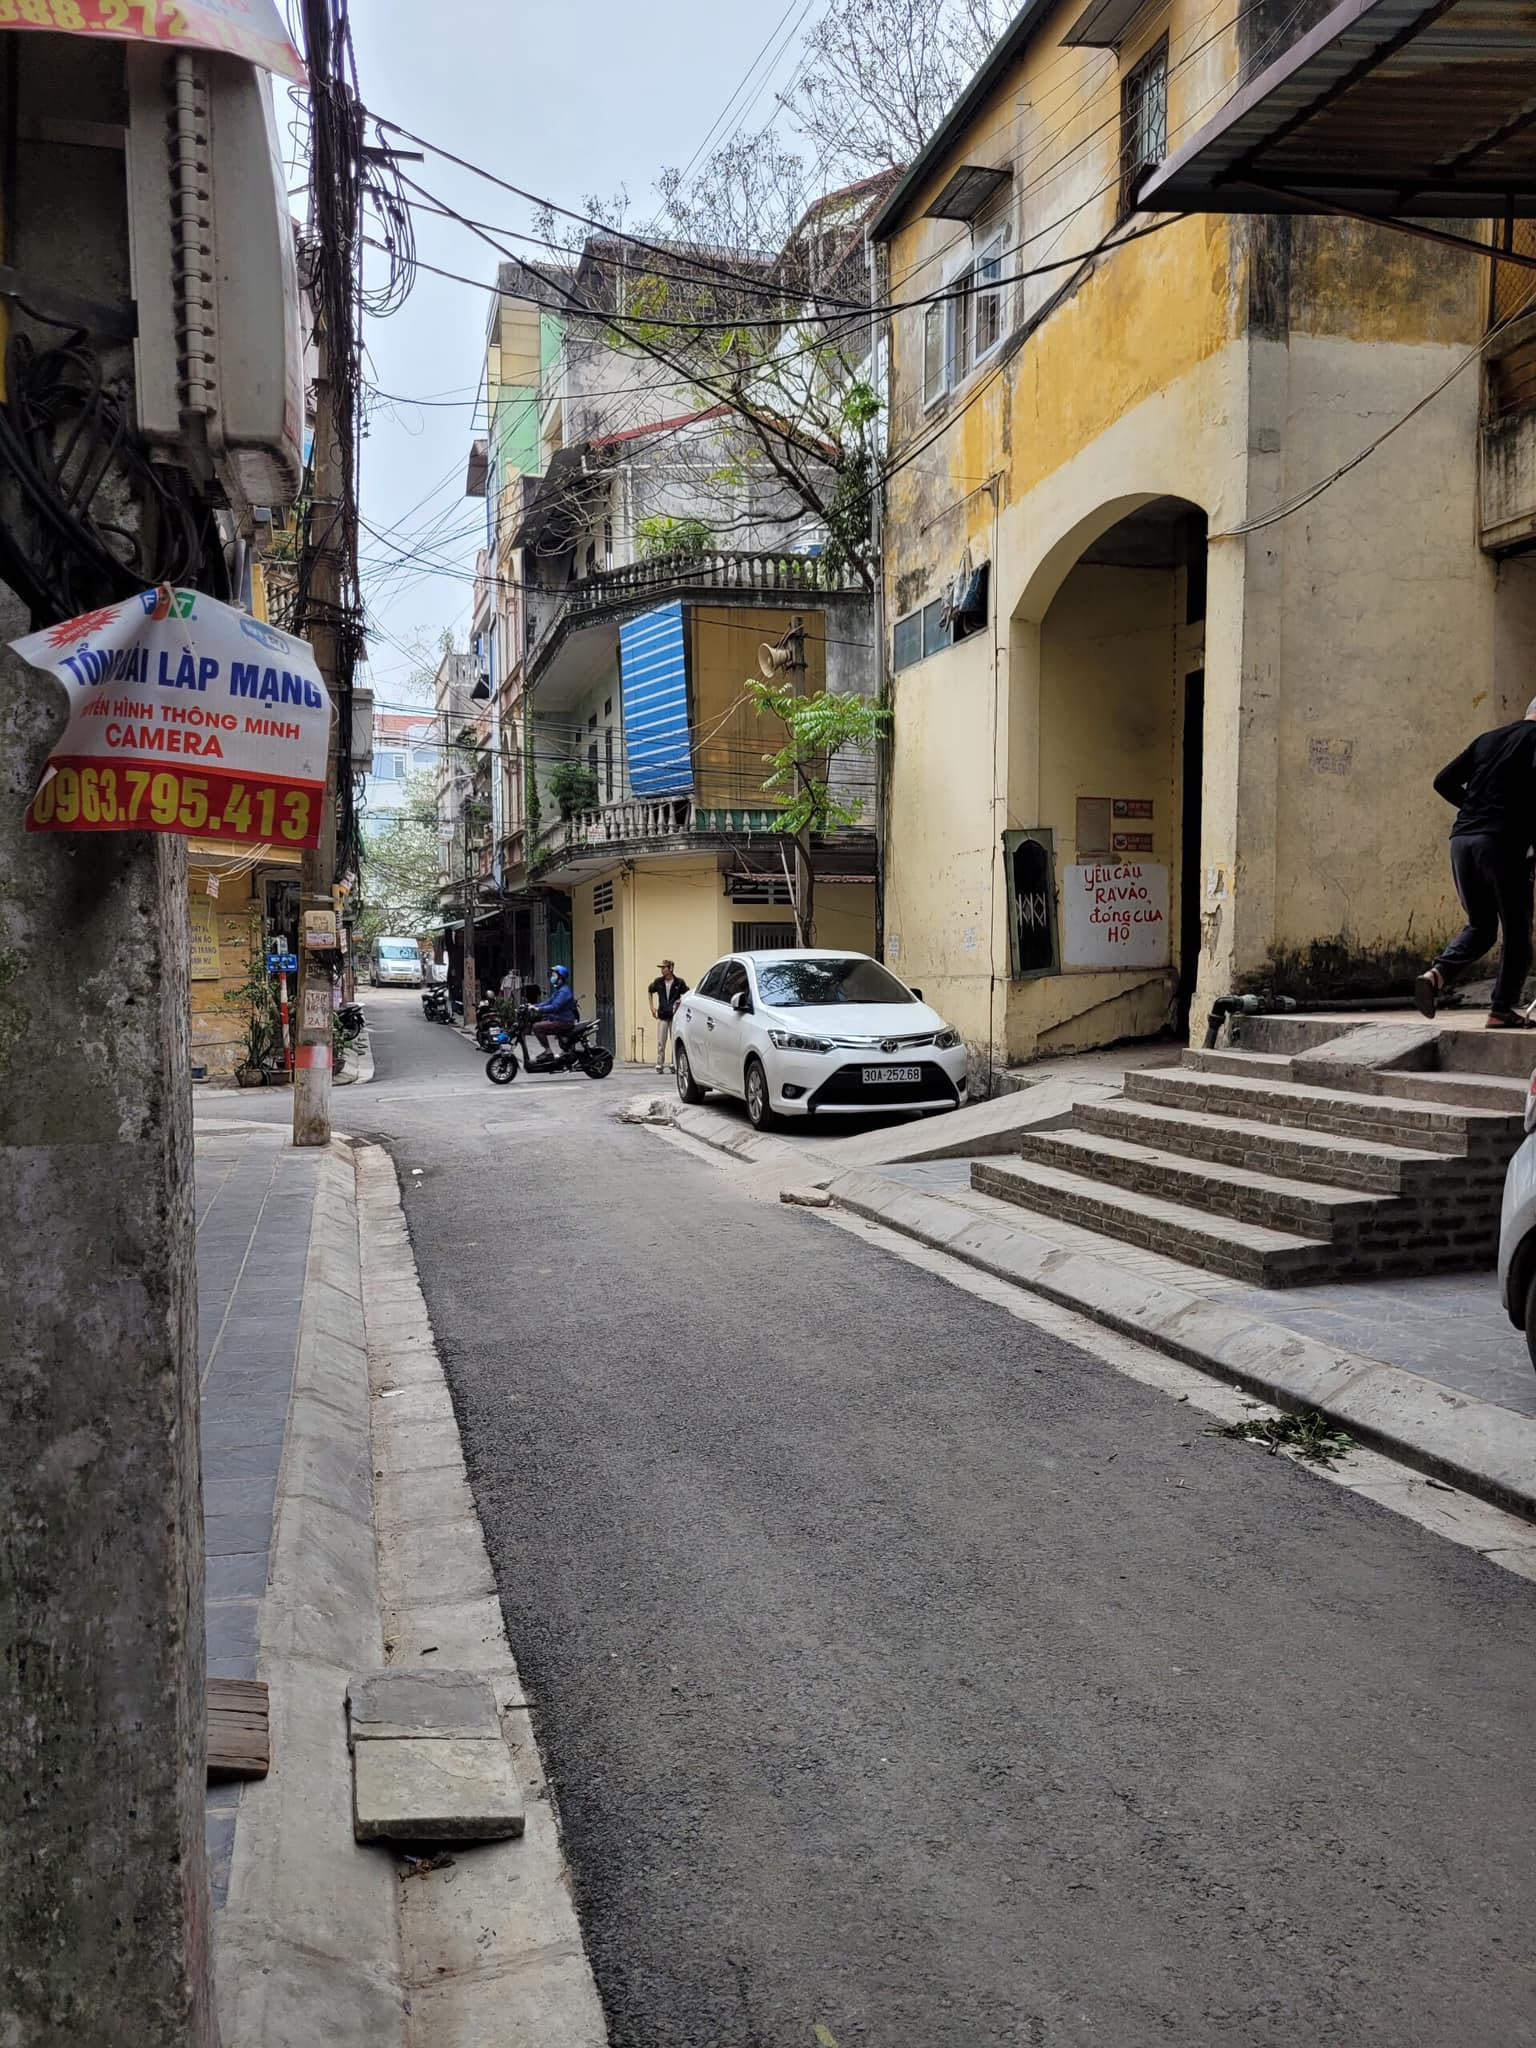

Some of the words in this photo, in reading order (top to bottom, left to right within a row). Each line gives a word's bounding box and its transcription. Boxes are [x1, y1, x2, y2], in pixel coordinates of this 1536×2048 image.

[230, 661, 322, 709] MẠNG
[113, 696, 153, 720] HÌNH
[161, 705, 238, 731] THÔNG
[245, 717, 300, 740] MINH
[105, 723, 224, 759] CAMERA
[33, 767, 311, 840] 0963.795.413
[864, 1068, 920, 1082] 30A-252.68
